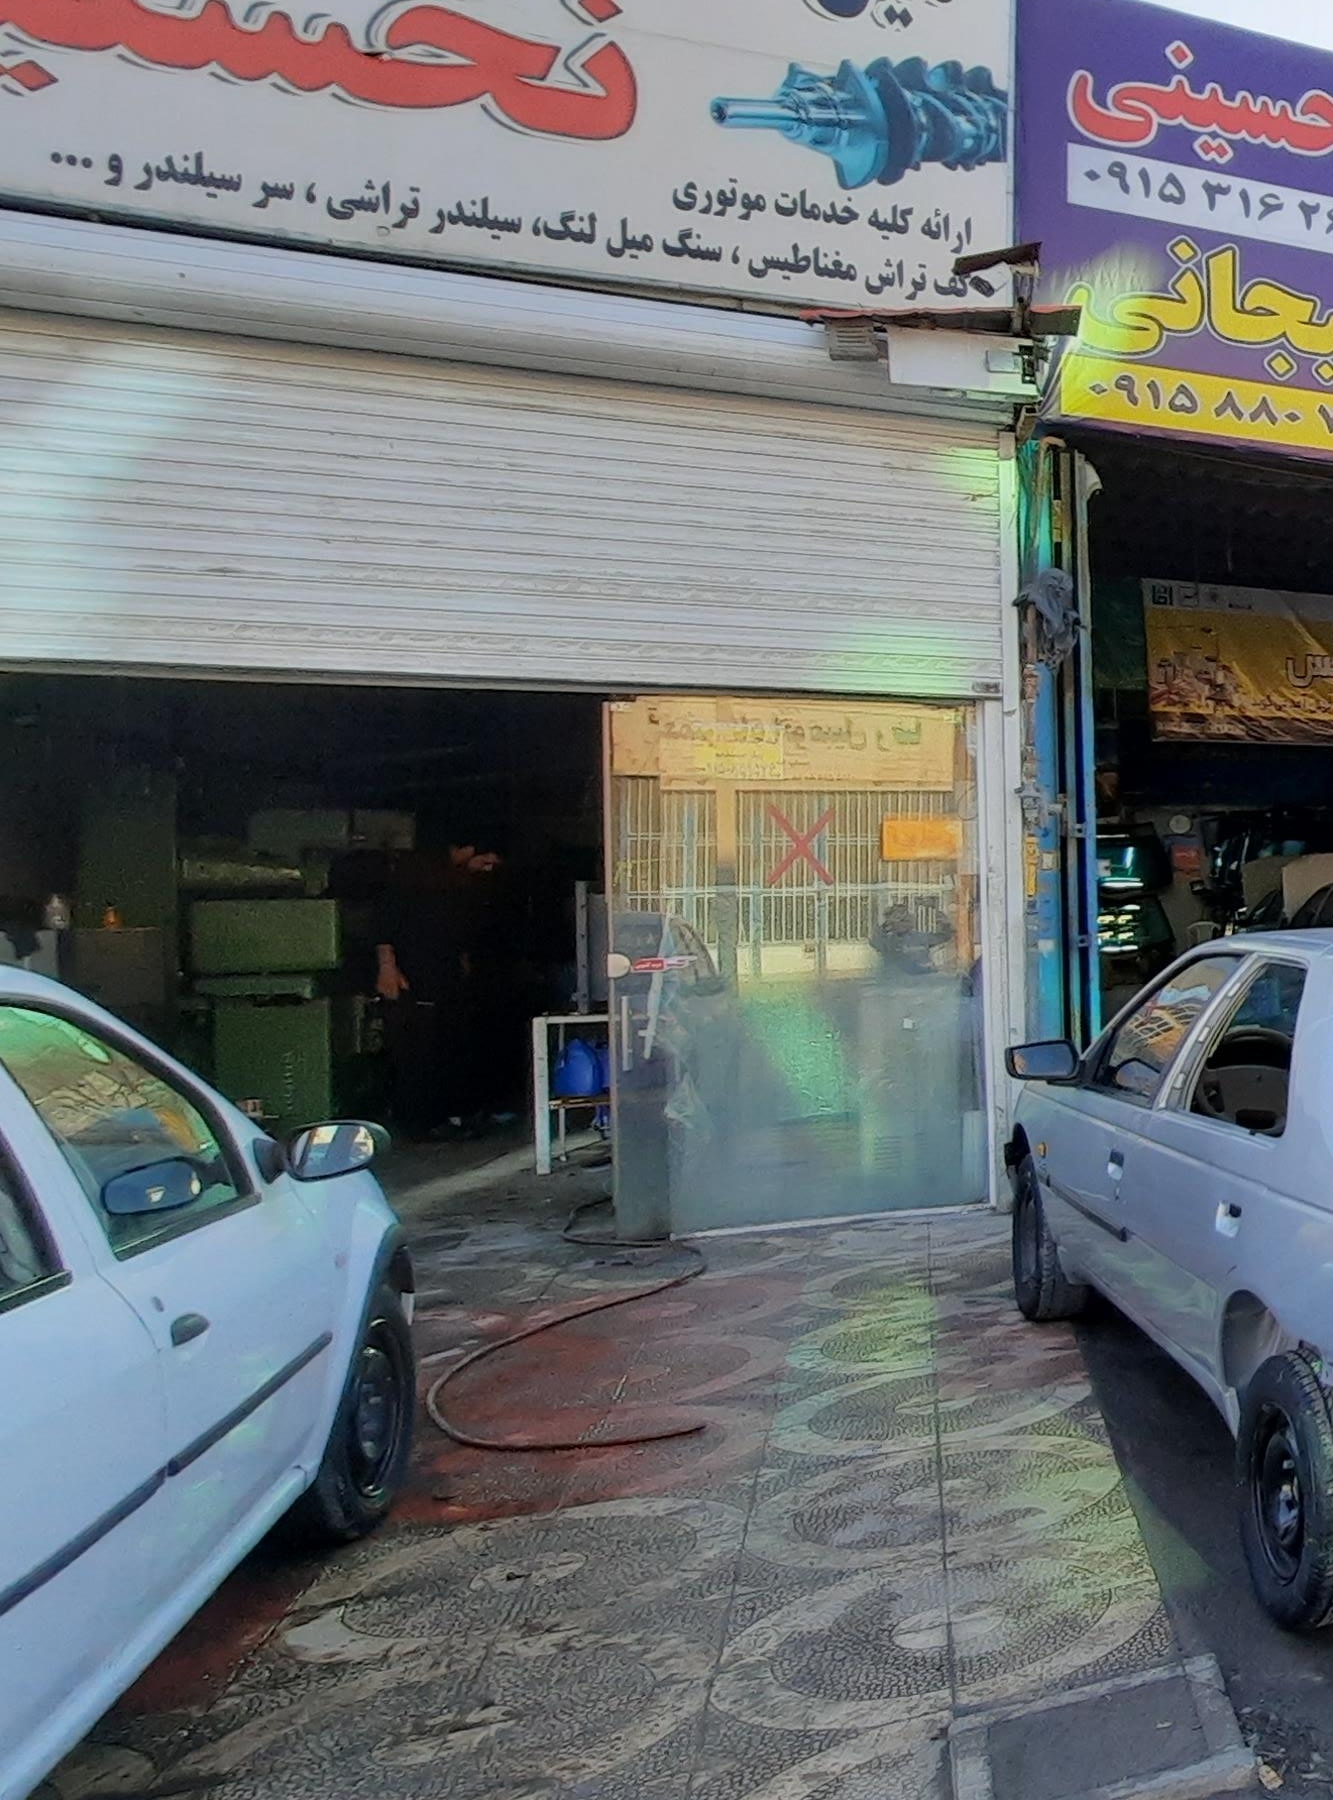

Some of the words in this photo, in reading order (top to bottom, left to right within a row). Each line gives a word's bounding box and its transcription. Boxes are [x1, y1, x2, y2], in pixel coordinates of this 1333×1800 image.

[104, 153, 123, 186] و
[134, 151, 242, 199] سیلندر
[252, 180, 294, 208] سر
[326, 178, 420, 229] تراشی
[672, 178, 767, 221] موتوری
[774, 188, 859, 224] خدمات
[1083, 161, 1187, 206] ۰۹۱۵
[1201, 178, 1285, 222] ۳۱۶
[429, 196, 522, 242] سیلندر
[605, 217, 654, 257] میل
[867, 207, 913, 237] کلیه
[919, 210, 974, 254] ارائه
[661, 228, 723, 263] سنگ
[747, 243, 858, 282] مغناطیس
[864, 259, 927, 301] تراش
[1088, 372, 1199, 415] ۰۹۱۵
[1213, 390, 1301, 428] ۸۸۰
